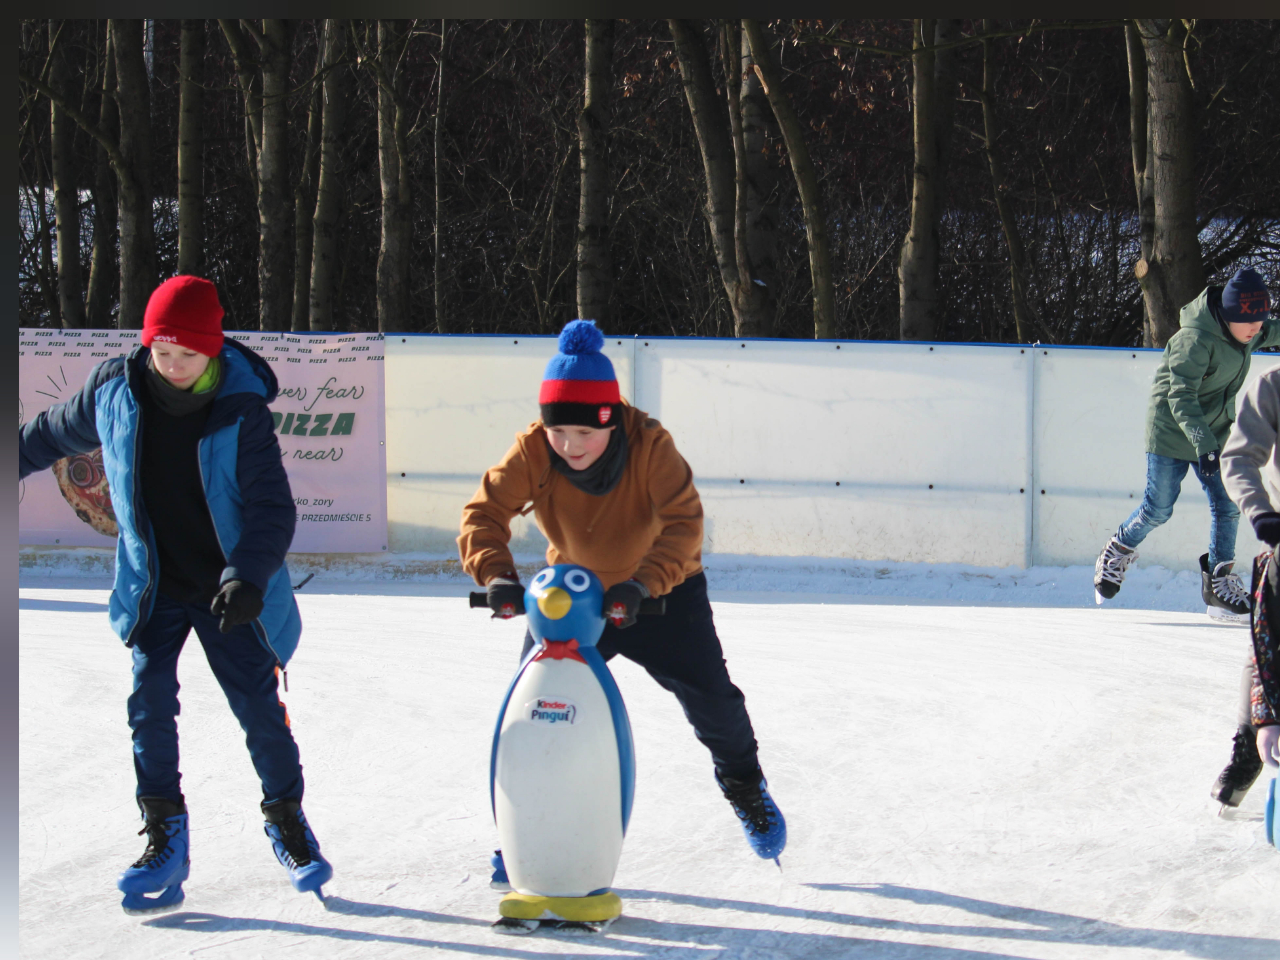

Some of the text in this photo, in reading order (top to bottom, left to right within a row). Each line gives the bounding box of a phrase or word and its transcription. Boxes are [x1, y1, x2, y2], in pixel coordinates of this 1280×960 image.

[278, 377, 364, 412] ver fear
[293, 448, 344, 461] near
